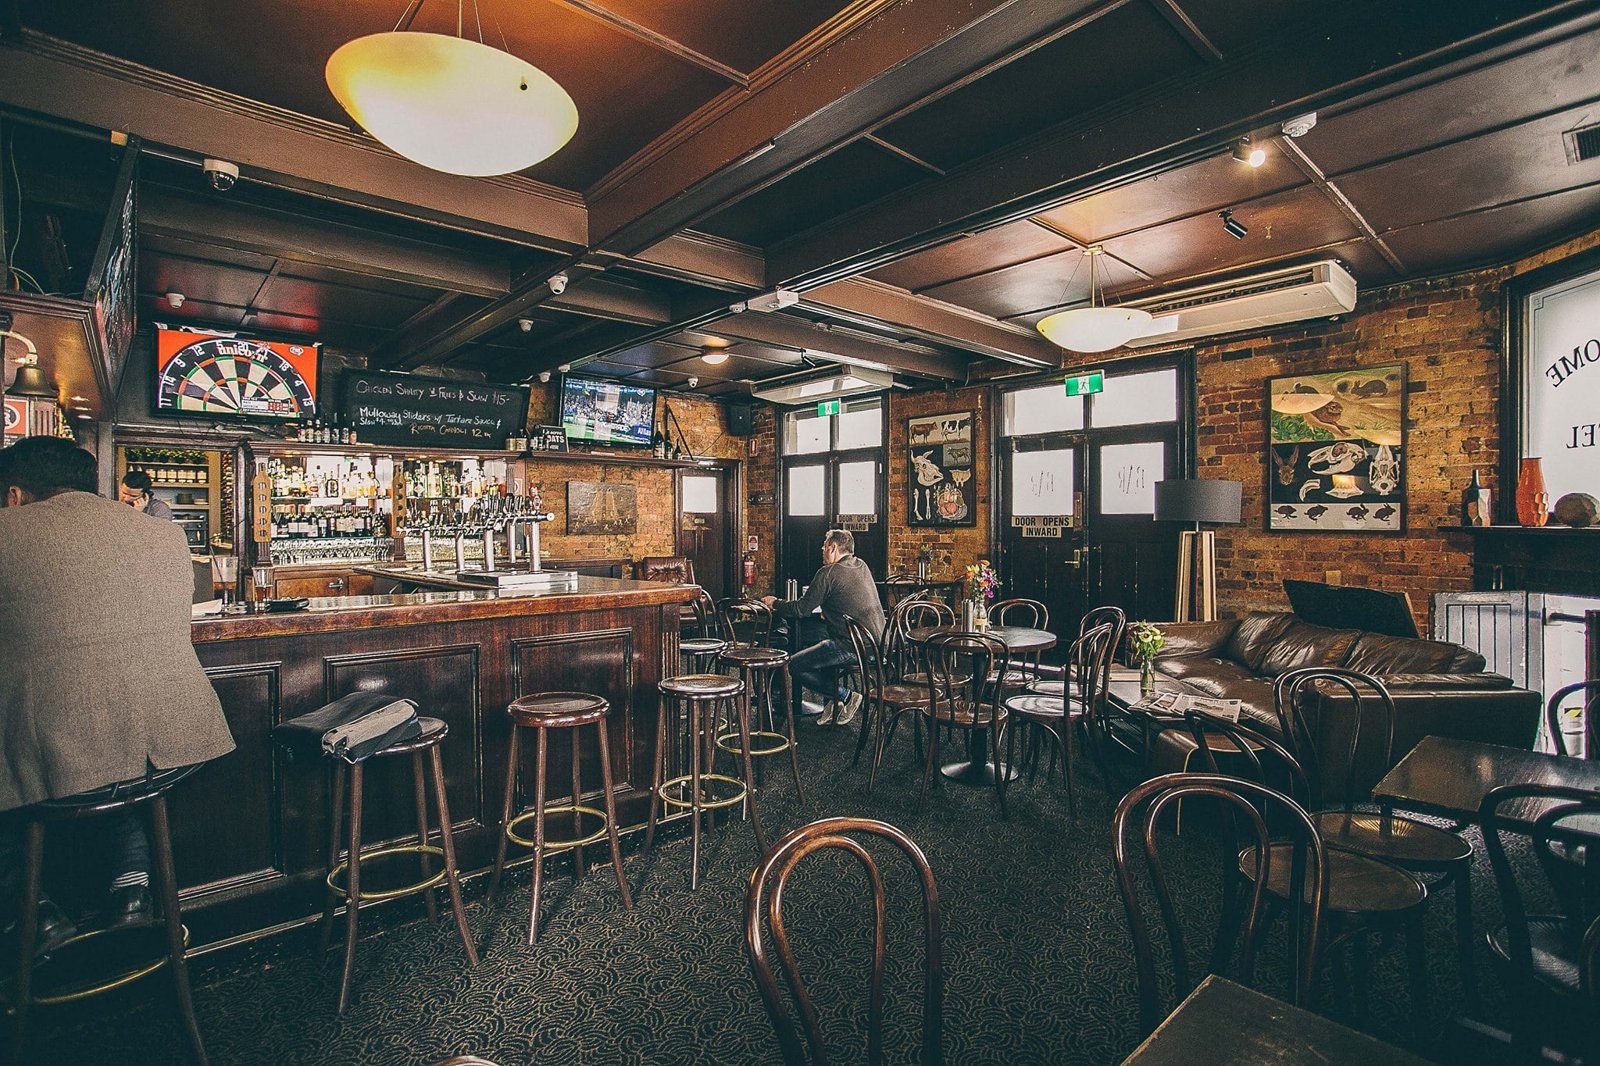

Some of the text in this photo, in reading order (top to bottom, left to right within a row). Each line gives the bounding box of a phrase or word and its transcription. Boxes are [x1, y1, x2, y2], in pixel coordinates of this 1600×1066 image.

[190, 344, 205, 357] 12
[174, 358, 186, 368] 9
[278, 360, 291, 372] 18
[163, 375, 177, 386] 14
[160, 397, 172, 407] 11
[302, 397, 314, 407] 13
[402, 409, 431, 422] Sliders
[857, 514, 875, 523] OPENS
[1015, 516, 1070, 527] DOOR OPENS
[1026, 527, 1058, 537] INWARD
